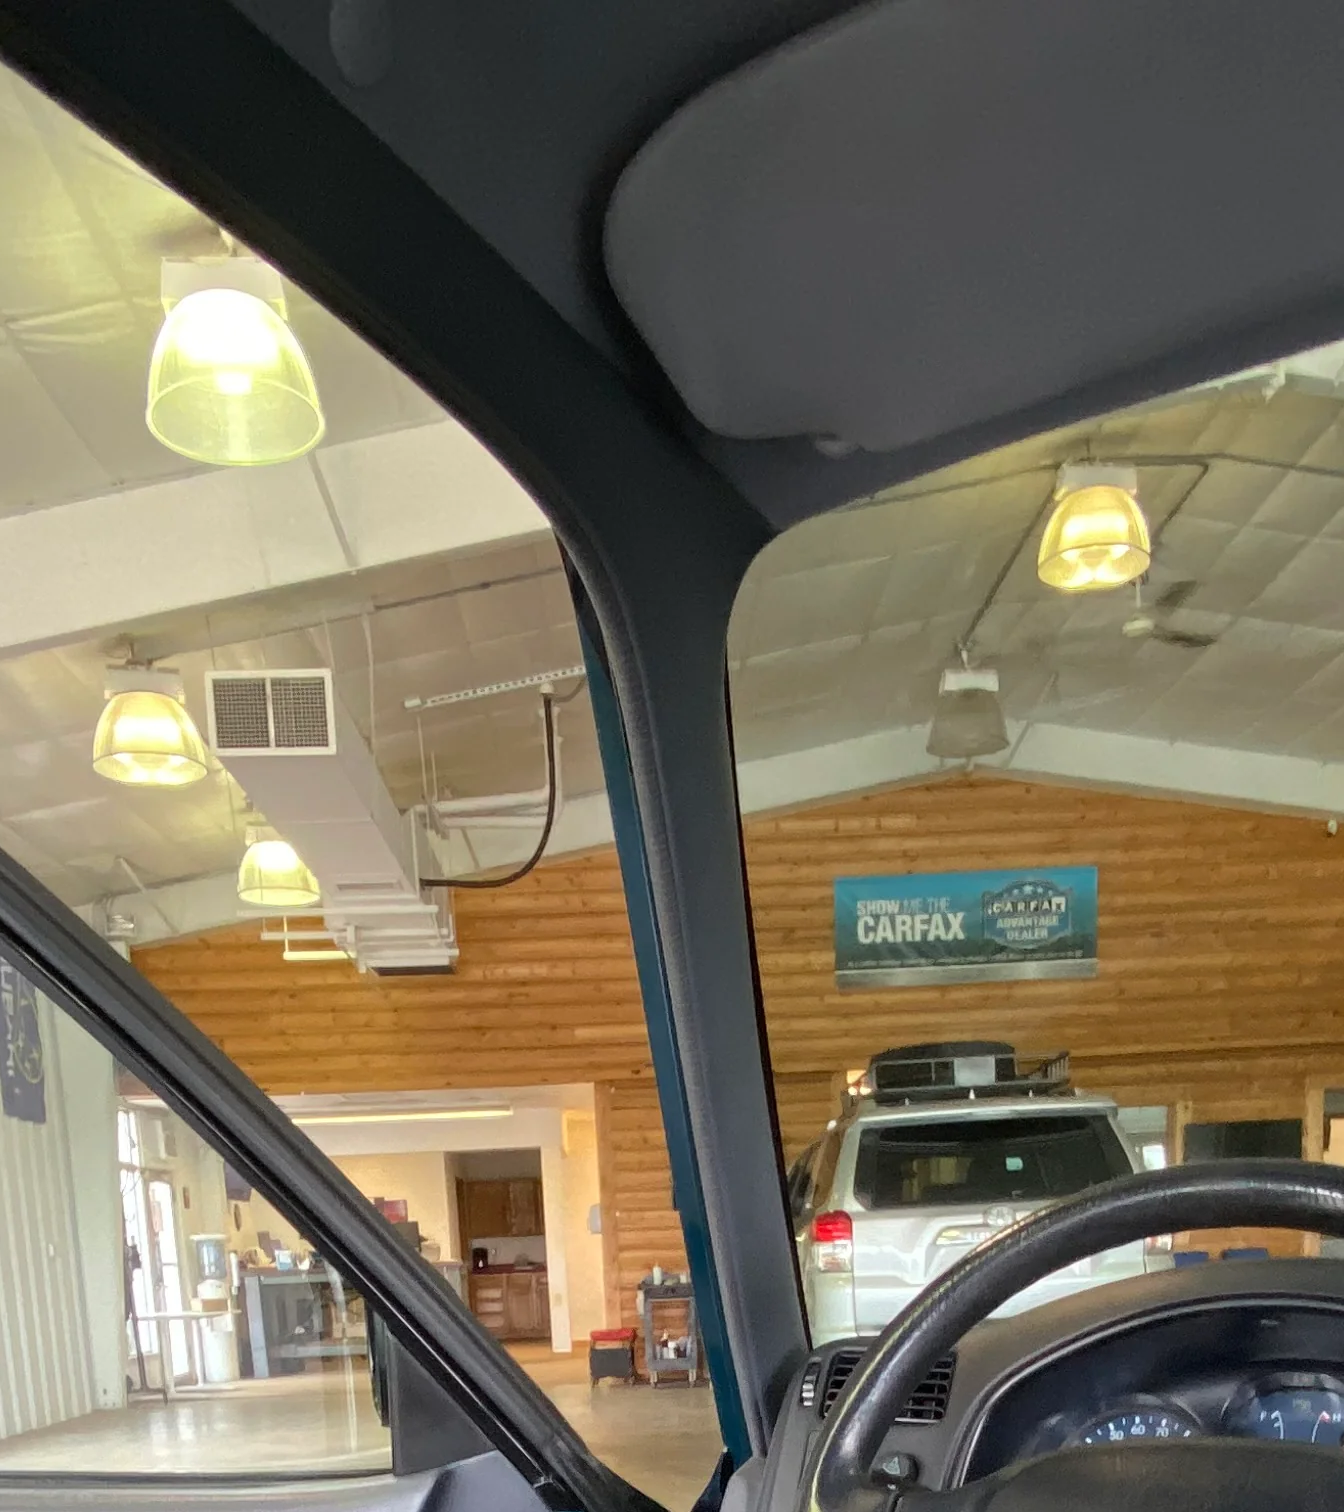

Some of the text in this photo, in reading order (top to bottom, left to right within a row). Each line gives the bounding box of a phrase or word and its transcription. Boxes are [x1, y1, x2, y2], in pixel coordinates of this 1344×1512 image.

[856, 899, 900, 916] SHOW
[857, 911, 966, 944] CARFAX
[1109, 1424, 1170, 1441] 50 60 70
